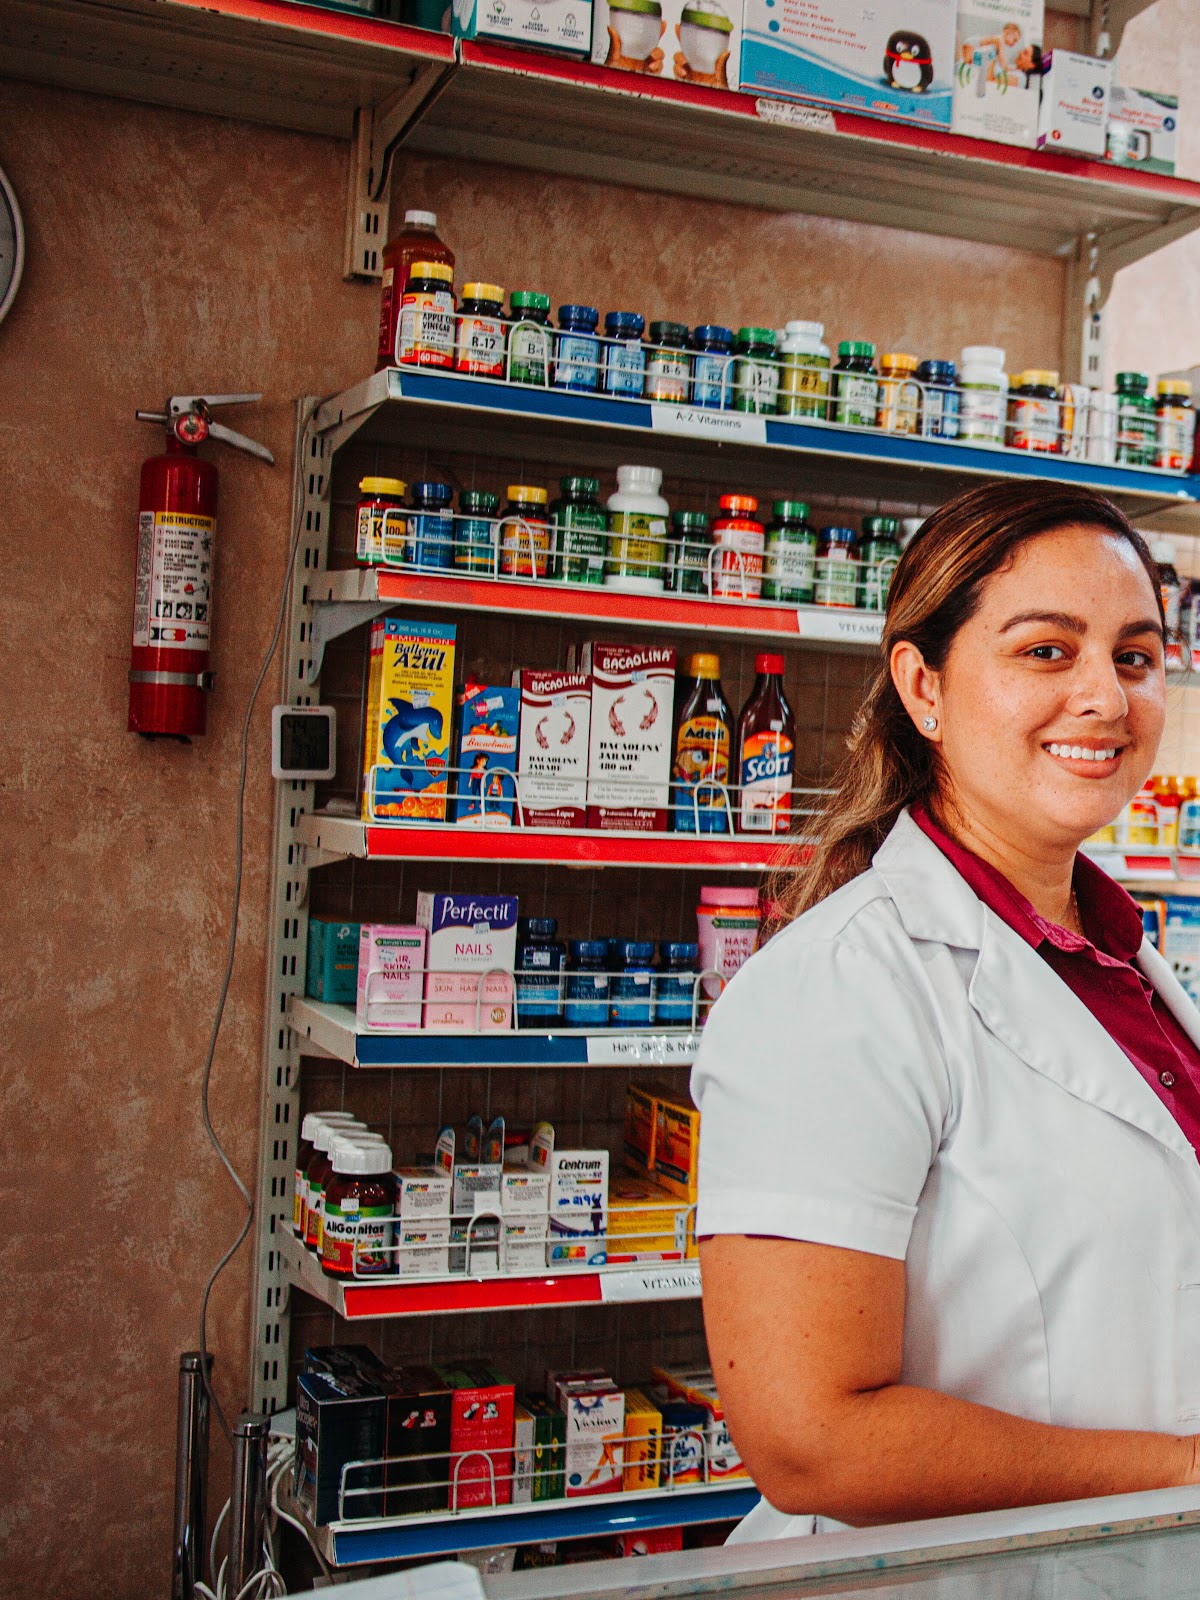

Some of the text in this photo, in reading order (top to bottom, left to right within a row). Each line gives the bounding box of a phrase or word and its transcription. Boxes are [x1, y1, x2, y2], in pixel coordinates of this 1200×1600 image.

[422, 312, 444, 321] APPLE
[422, 321, 451, 332] VINEGAR
[420, 352, 431, 362] 60
[662, 364, 681, 376] B-6
[676, 411, 742, 428] A-Z Vitamins
[391, 634, 450, 645] EMULSION
[394, 643, 440, 656] Ballena
[392, 652, 446, 671] Azul
[603, 651, 670, 670] BACAOLINA
[532, 675, 586, 692] BACAOLINA
[600, 742, 660, 753] BACAOLINA
[528, 755, 577, 765] BACAOLINA
[599, 753, 640, 762] JARABE
[528, 764, 562, 772] JARABE
[440, 897, 509, 924] Perfectil
[455, 943, 493, 955] NAILS
[383, 971, 410, 981] NAILS
[486, 985, 508, 993] NAILS
[559, 1159, 601, 1170] Centrum
